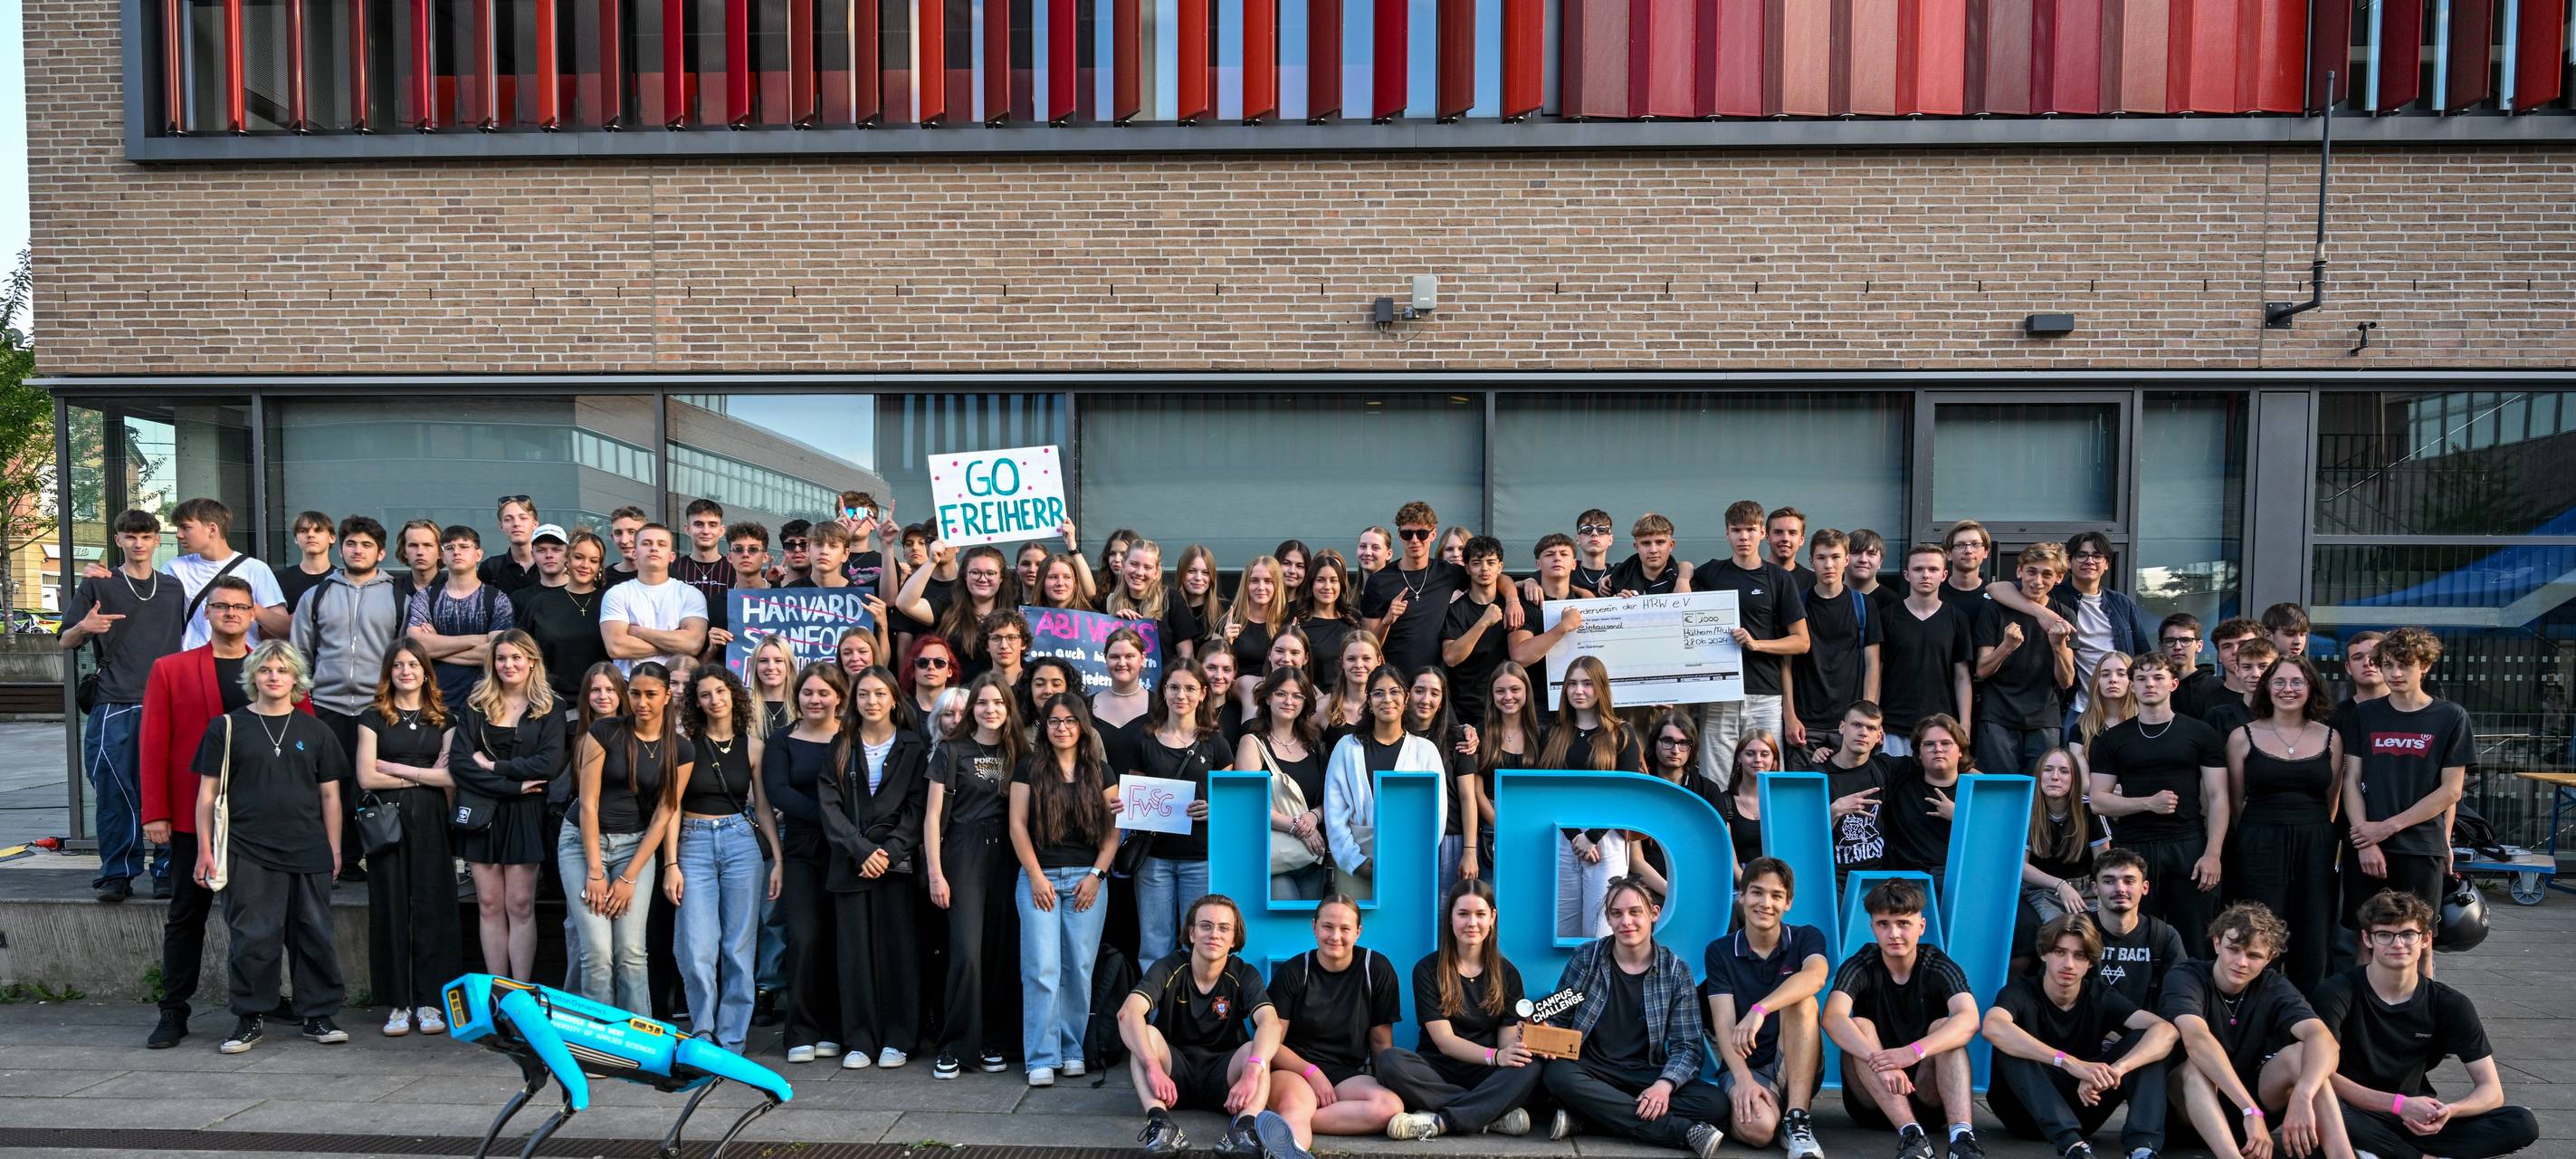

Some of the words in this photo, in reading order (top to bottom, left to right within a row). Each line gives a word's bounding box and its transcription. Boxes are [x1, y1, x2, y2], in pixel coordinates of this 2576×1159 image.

[966, 457, 1020, 497] GO
[939, 496, 1064, 540] FREIHERR
[742, 593, 863, 624] HARVARD
[1643, 598, 1667, 609] HRW
[1035, 610, 1081, 640] ABI
[1086, 615, 1156, 653] VES
[1699, 616, 1719, 624] 1000
[741, 625, 870, 656] SANFO
[1055, 647, 1086, 660] auch
[1532, 992, 1585, 1023] CHALLENGE
[1535, 988, 1573, 1011] CAMPUS
